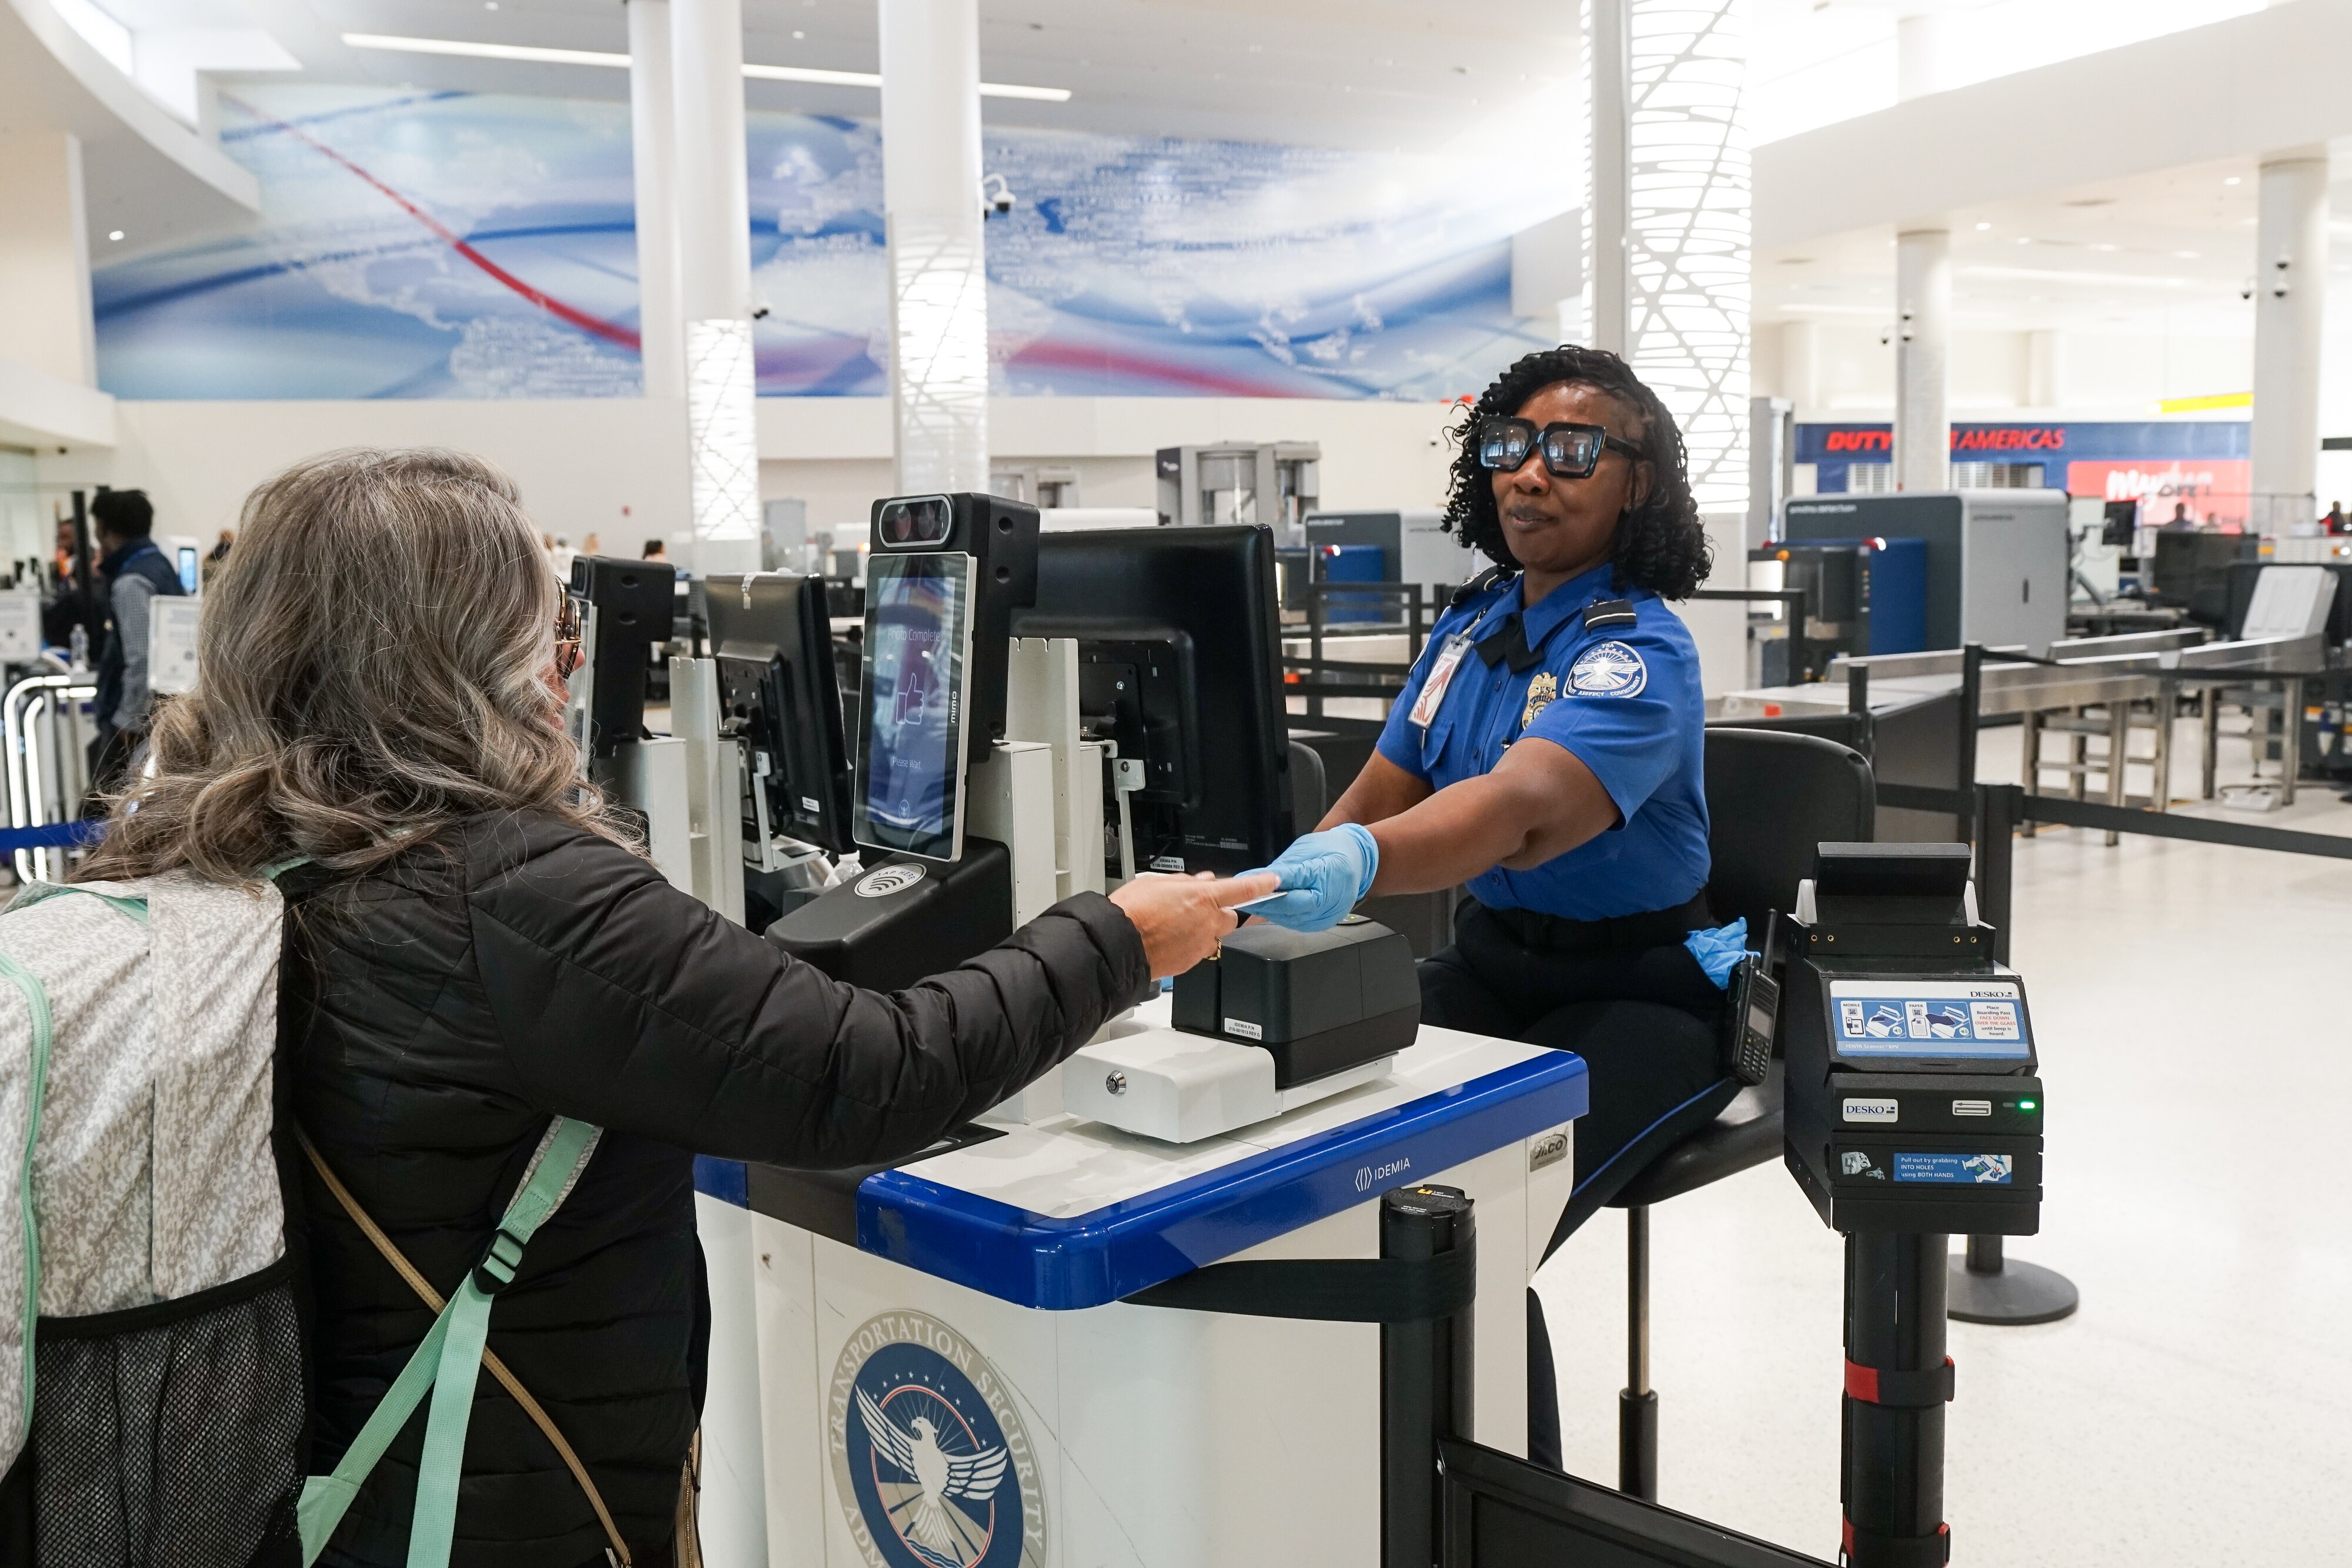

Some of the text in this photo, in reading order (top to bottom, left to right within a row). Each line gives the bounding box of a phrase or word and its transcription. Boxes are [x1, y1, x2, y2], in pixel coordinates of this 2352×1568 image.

[1826, 430, 1893, 450] DUTY
[1957, 429, 2066, 450] AMERICAS
[908, 628, 940, 643] Complete
[893, 756, 908, 767] Please
[900, 871, 916, 881] HERE
[1846, 1105, 1885, 1114] DESKO
[1375, 1157, 1410, 1181] IDEMIA
[832, 1316, 1045, 1550] TRANSPORTATION SECURITY
